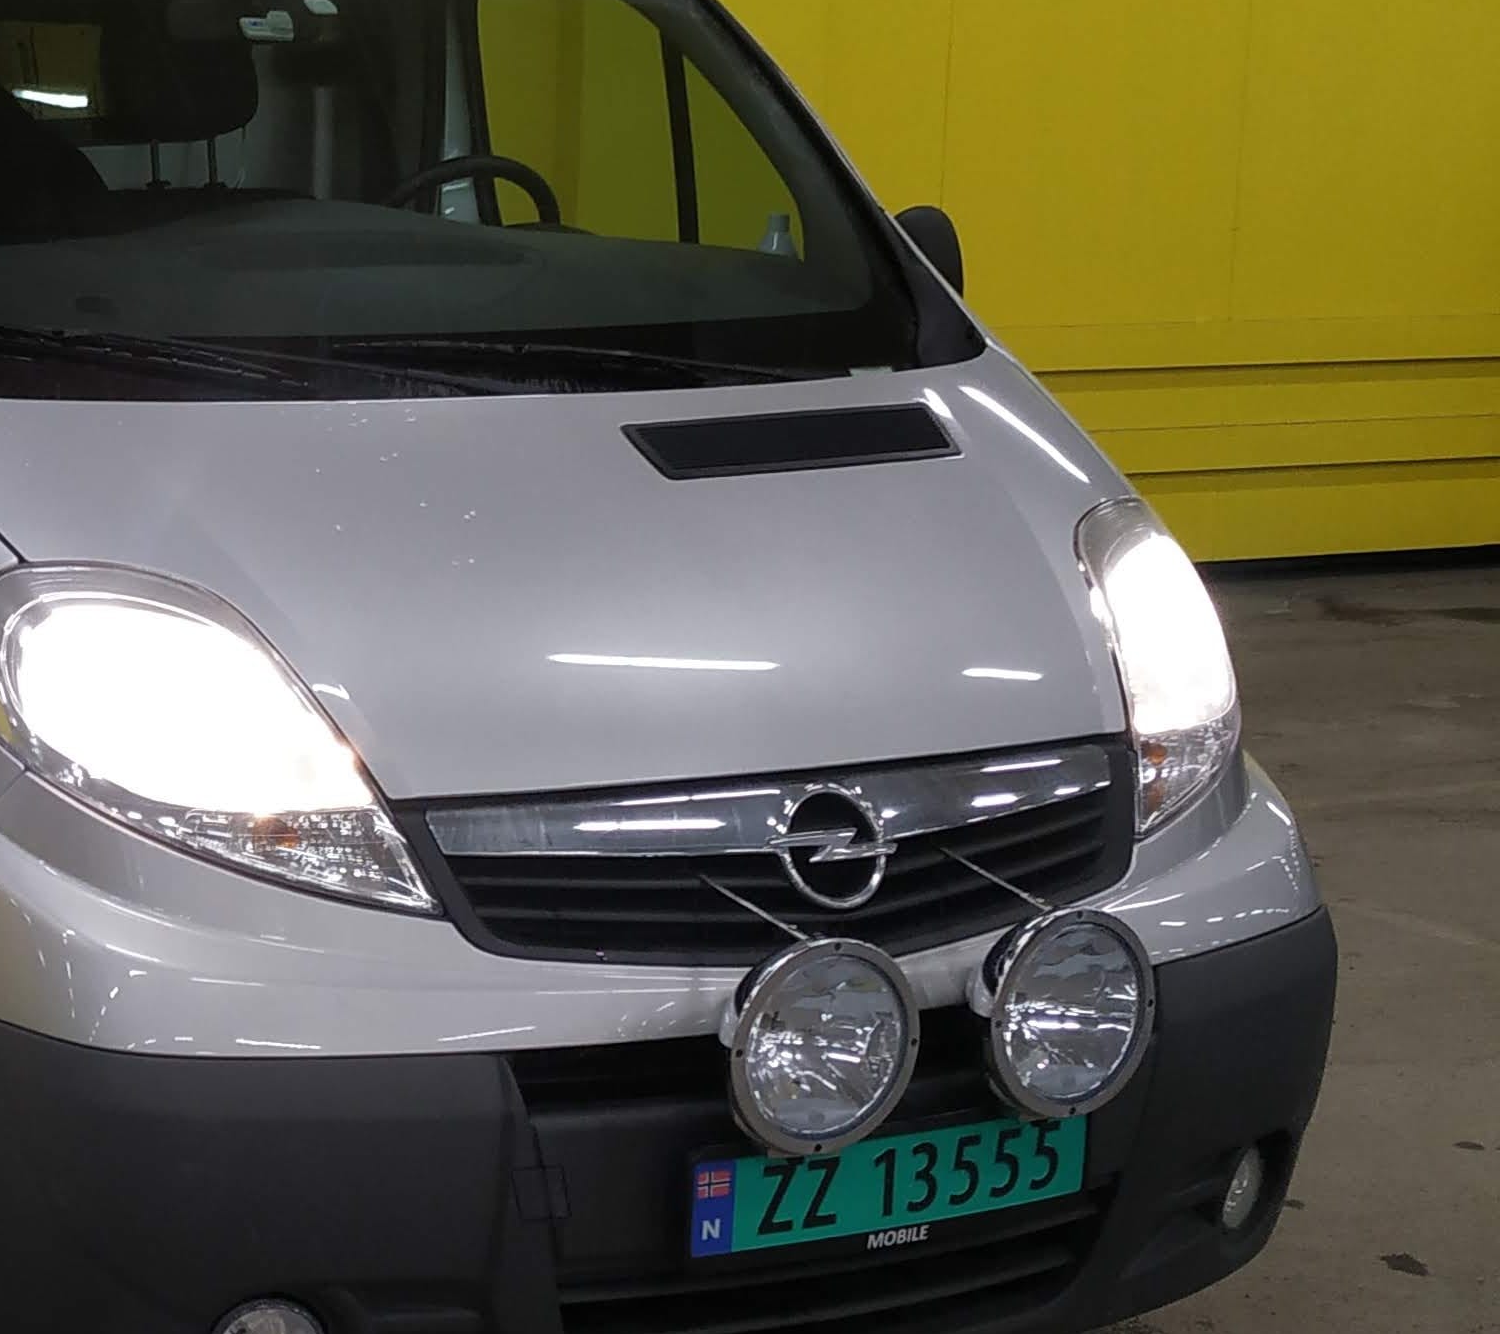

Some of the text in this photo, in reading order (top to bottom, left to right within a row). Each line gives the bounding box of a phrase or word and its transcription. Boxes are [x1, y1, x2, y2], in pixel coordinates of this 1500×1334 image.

[756, 1122, 1060, 1237] ZZ 13555
[700, 1218, 721, 1241] N
[866, 1224, 930, 1250] MOBILE
